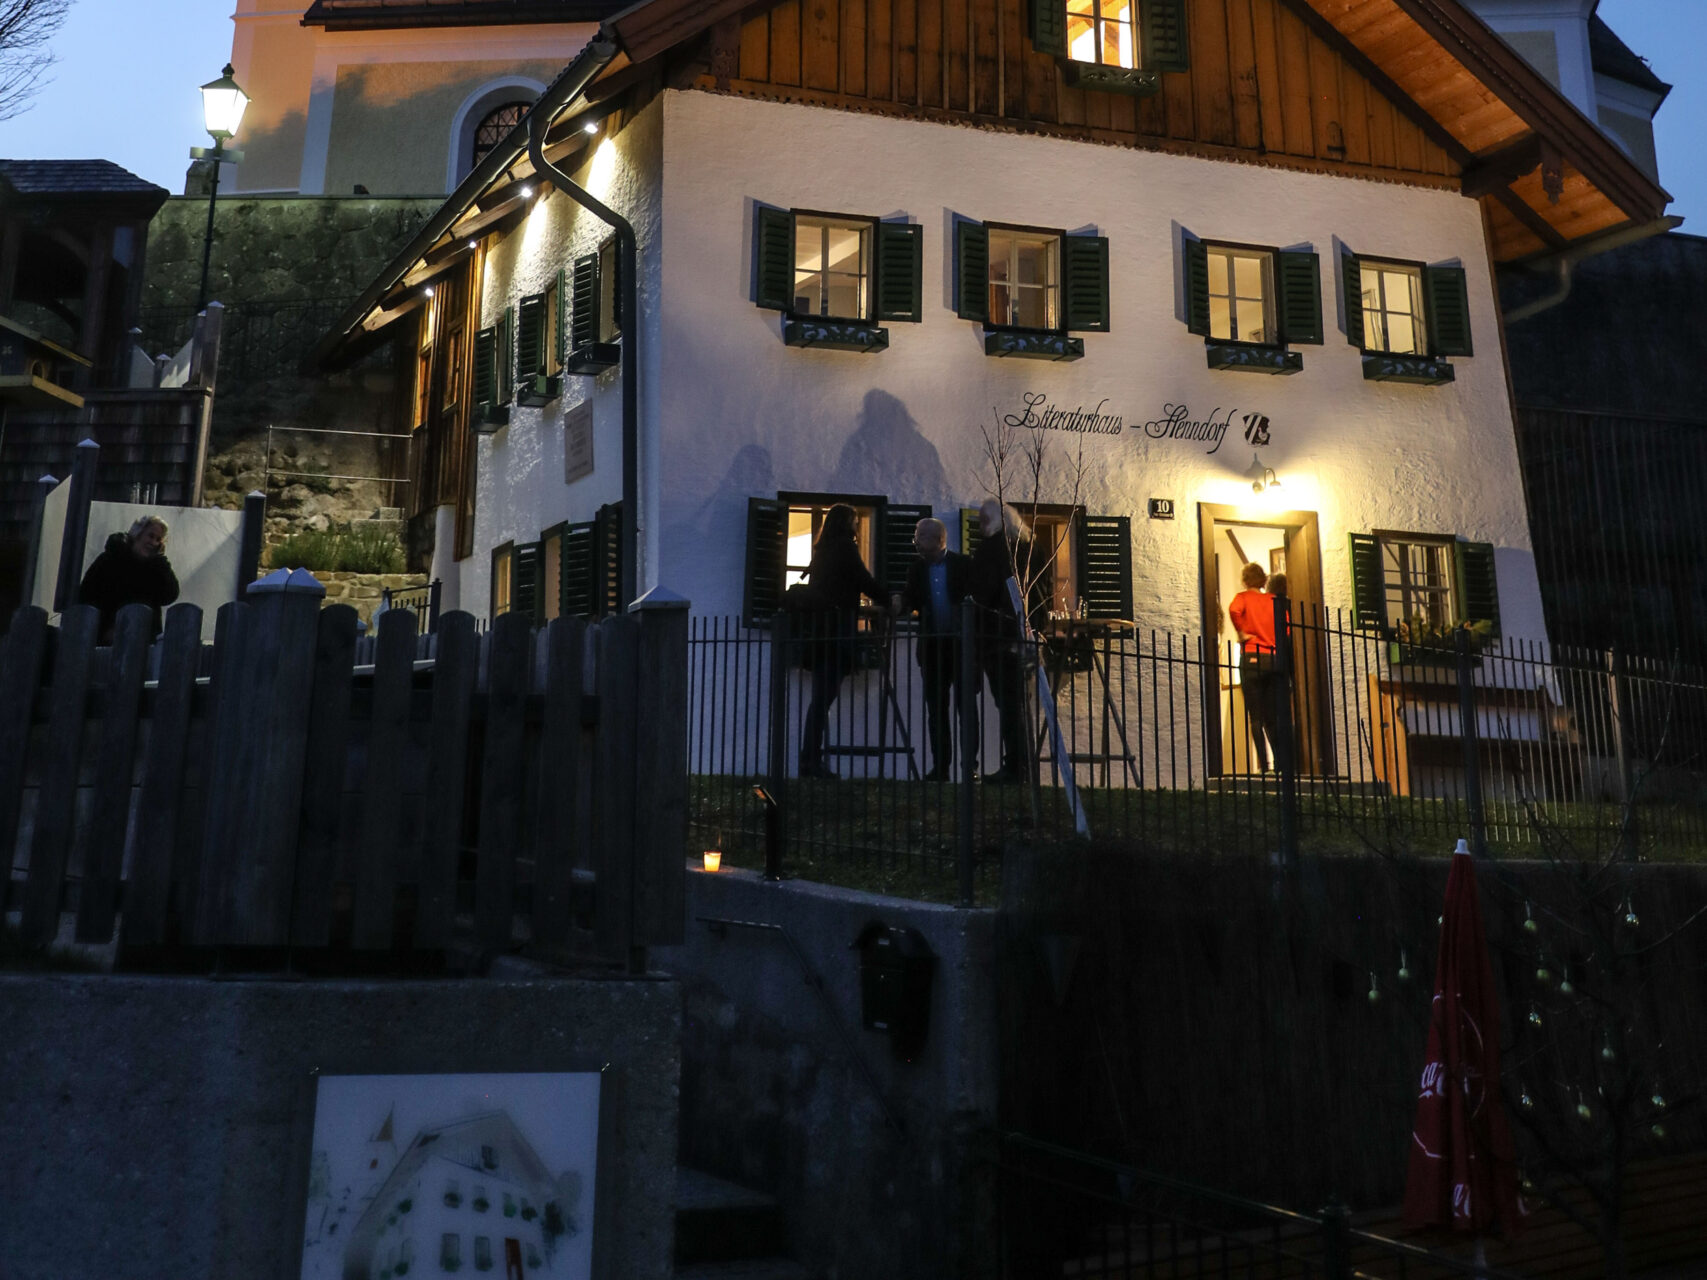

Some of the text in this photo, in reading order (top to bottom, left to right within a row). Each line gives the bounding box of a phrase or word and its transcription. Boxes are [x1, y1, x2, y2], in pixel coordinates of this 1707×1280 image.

[1004, 392, 1123, 435] Literaturhaus
[1145, 403, 1238, 455] Henndorf
[1156, 500, 1170, 513] 10
